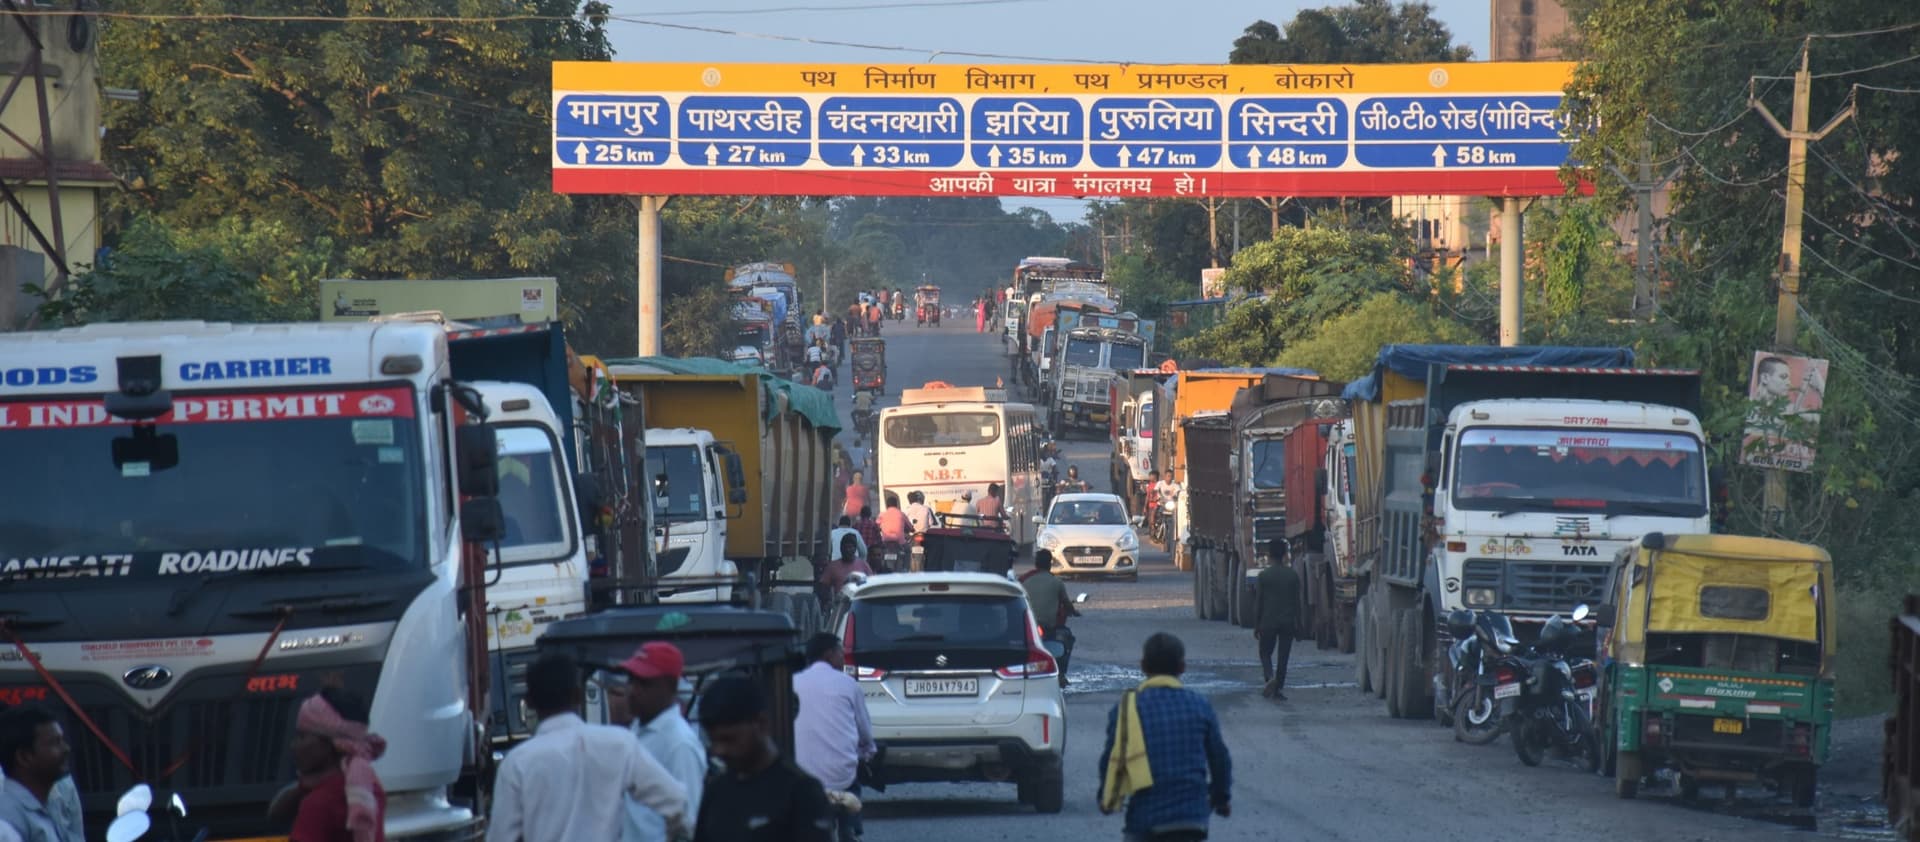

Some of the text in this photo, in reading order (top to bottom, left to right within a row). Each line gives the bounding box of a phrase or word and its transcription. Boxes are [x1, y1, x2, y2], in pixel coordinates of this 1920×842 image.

[803, 71, 835, 88] पथ
[865, 67, 936, 90] निर्माण
[1075, 71, 1109, 90] पथ
[1275, 66, 1355, 90] बोकारो
[568, 100, 660, 136] मानपुर
[687, 100, 803, 134] पाथरडीह
[826, 101, 959, 136] चंदनक्यारी
[984, 101, 1070, 136] झरिया
[1239, 102, 1338, 138] सिन्दरी
[595, 144, 655, 163] 25 km
[728, 144, 786, 163] 27 km
[873, 145, 930, 164] 33 km
[1009, 146, 1067, 166] 35 km
[1137, 147, 1196, 166] 47 km
[1267, 147, 1327, 166] 48 km
[1457, 145, 1516, 164] 58 km
[928, 172, 993, 194] आपकी
[1013, 175, 1057, 194] यात्रा
[1072, 174, 1152, 194] मंगलमय
[0, 356, 332, 386] ODS CARRIER
[172, 395, 346, 423] PERMIT
[923, 468, 967, 481] N.B.T.
[158, 547, 315, 576] ROADLINES
[1561, 545, 1597, 556] TATA
